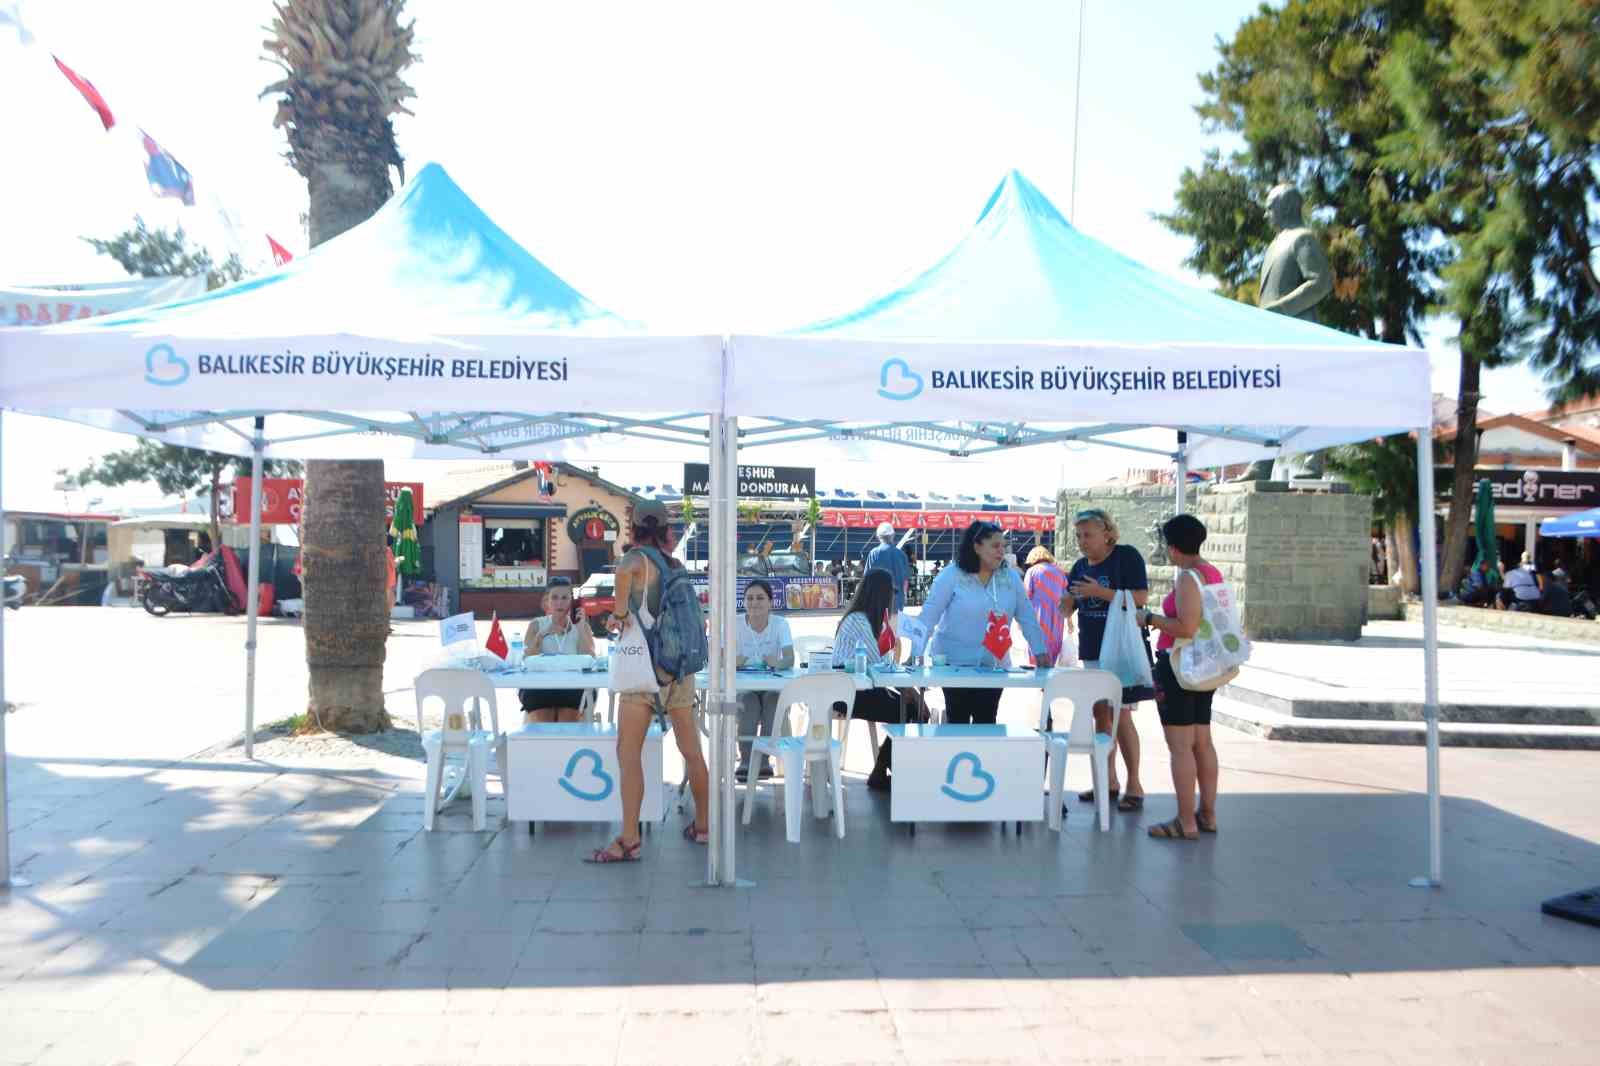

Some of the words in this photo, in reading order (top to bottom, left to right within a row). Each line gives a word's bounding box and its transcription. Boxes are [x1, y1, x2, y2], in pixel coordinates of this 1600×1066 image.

[198, 351, 304, 375] BALIKESİR
[312, 352, 445, 381] BÜYÜKŞEHİR
[452, 356, 568, 381] BELEDİYESİ
[932, 366, 1033, 390] BALIKESİR
[1041, 366, 1165, 394] BÜYÜKŞEHİR
[1173, 365, 1281, 390] BELEDİYESİ
[738, 467, 775, 480] EŞHUR
[740, 482, 809, 495] DONDURMA
